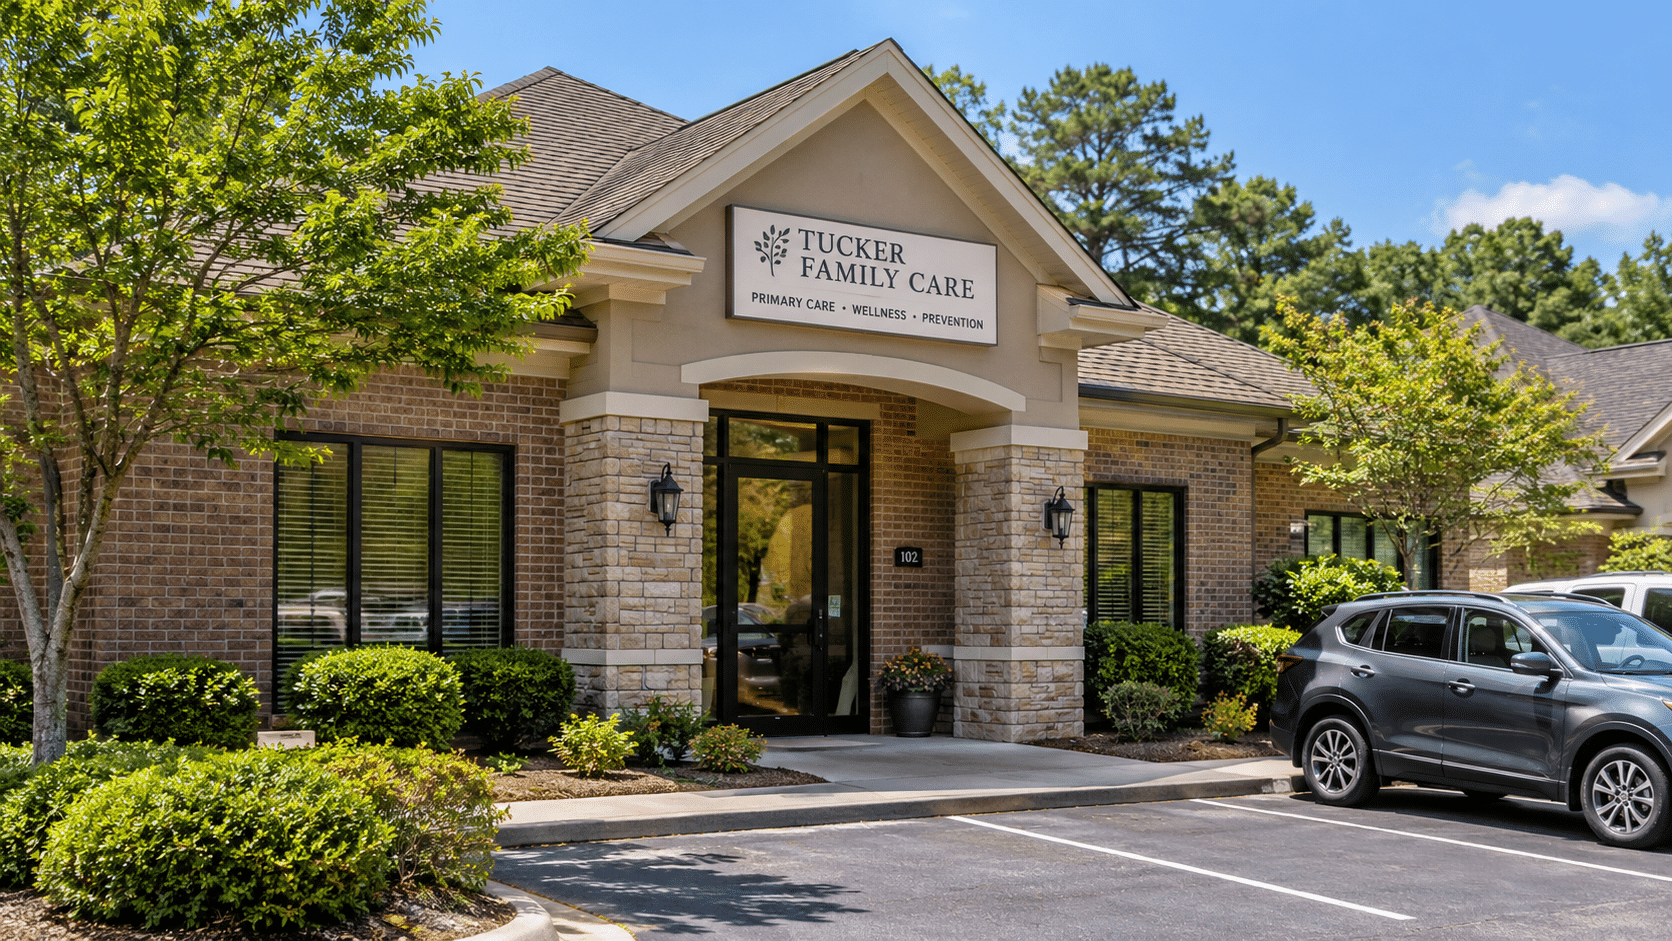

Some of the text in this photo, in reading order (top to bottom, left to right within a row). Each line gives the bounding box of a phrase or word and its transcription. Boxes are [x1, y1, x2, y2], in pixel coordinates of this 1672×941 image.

[798, 228, 906, 265] TUCKER
[800, 256, 975, 300] FAMILY CARE
[751, 291, 984, 330] PRIMARY CARE WELLNESS PREVENTION
[901, 551, 918, 563] 102
